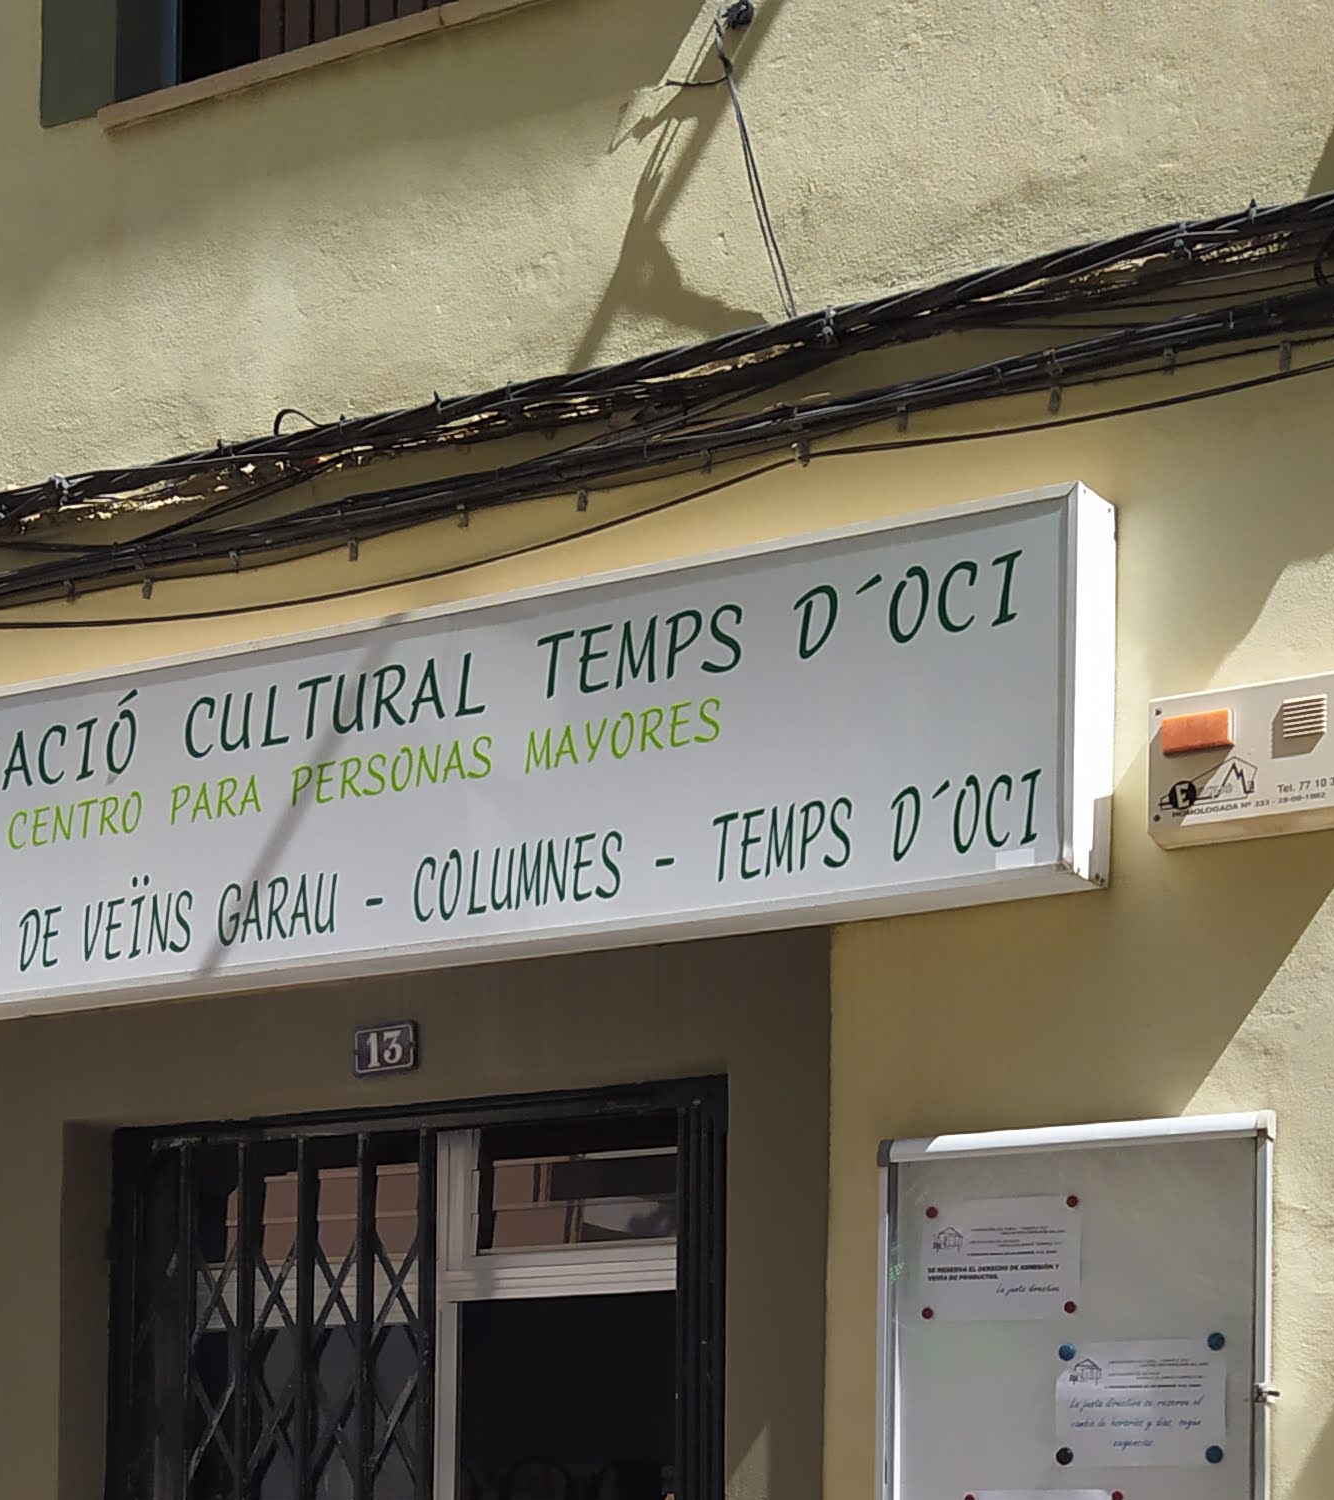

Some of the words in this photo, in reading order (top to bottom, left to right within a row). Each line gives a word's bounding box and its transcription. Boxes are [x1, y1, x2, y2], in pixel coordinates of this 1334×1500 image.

[186, 652, 486, 759] CULTURAL
[537, 604, 744, 700] TEMPS
[7, 791, 142, 850] CENTRO
[170, 775, 261, 826] PARA
[291, 735, 493, 808] PERSONAS
[524, 698, 722, 774] MAYORES
[1172, 803, 1238, 818] HOMOLOGADA
[1277, 783, 1296, 794] Tel.
[1299, 780, 1311, 791] 77
[1315, 778, 1327, 788] 10
[19, 906, 62, 973] DE
[82, 875, 193, 962] VEÏNS
[217, 872, 338, 948] GARAU
[413, 830, 622, 924] COLUMNES
[712, 797, 853, 883] TEMPS
[366, 1029, 404, 1069] 13
